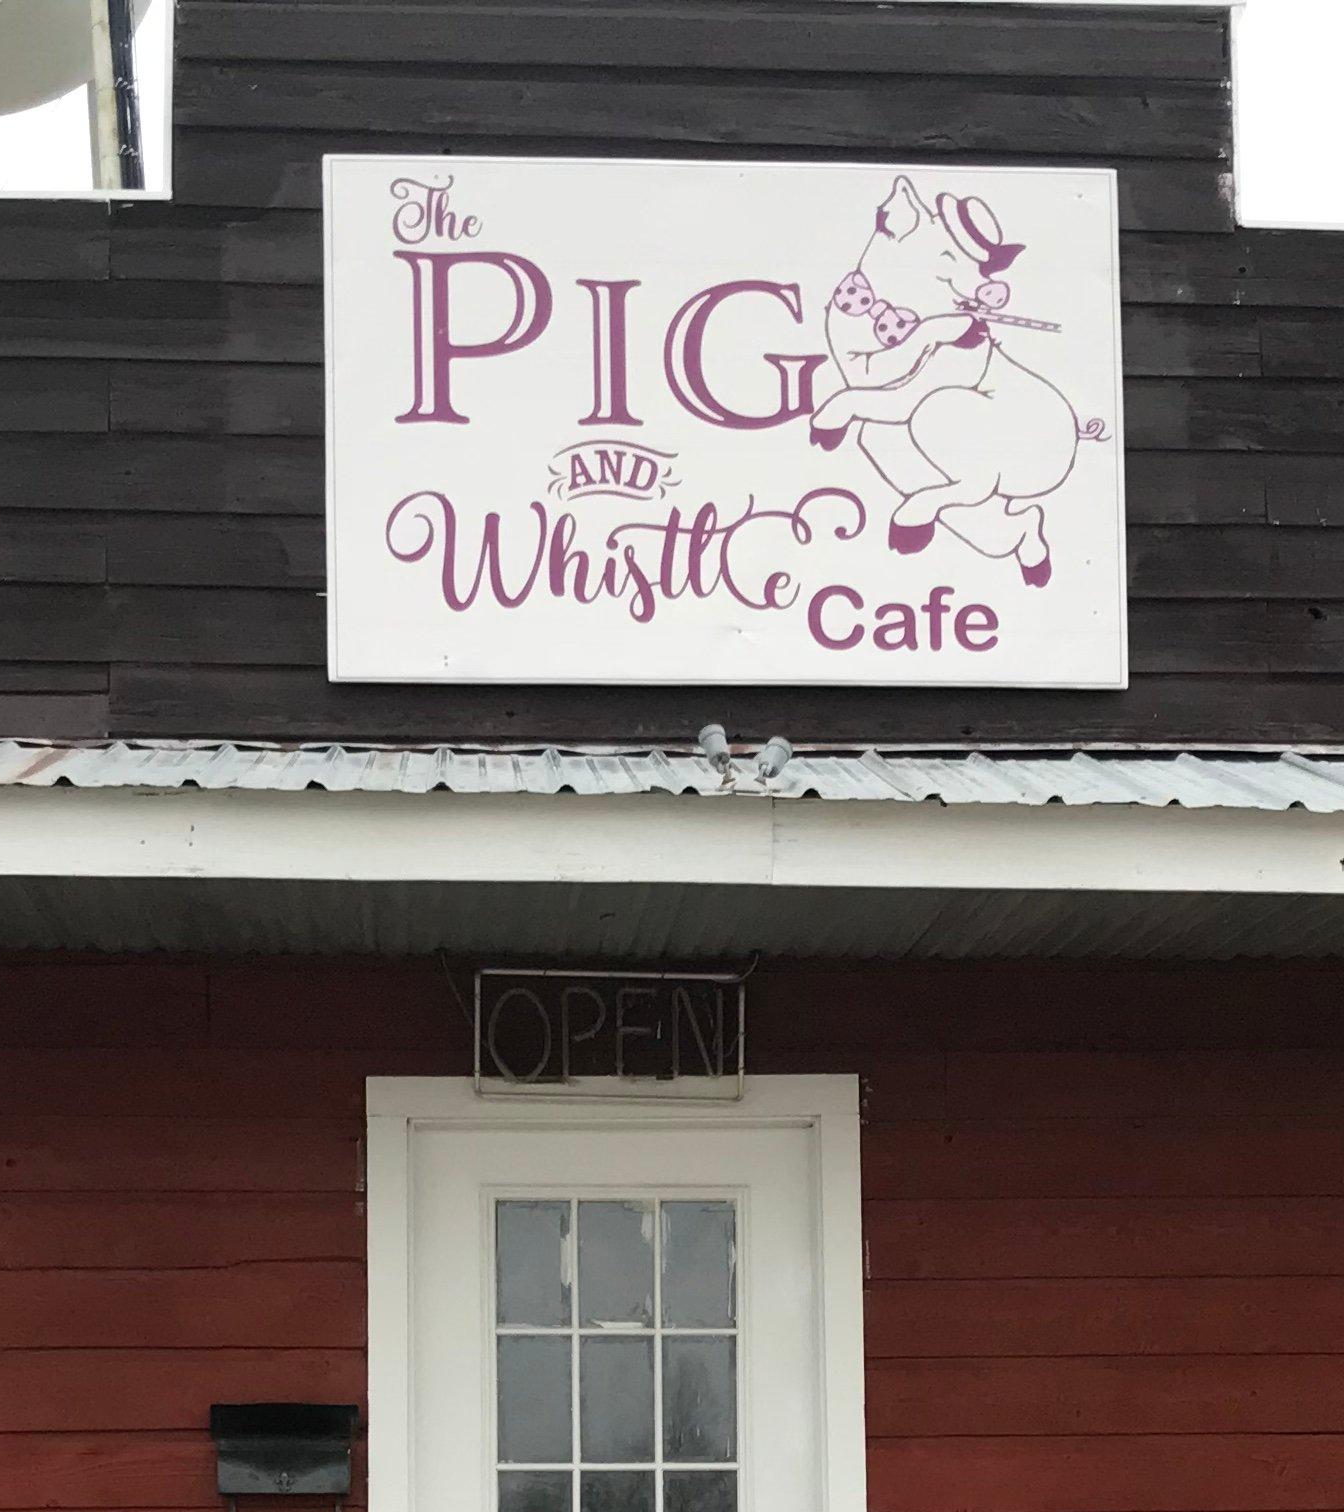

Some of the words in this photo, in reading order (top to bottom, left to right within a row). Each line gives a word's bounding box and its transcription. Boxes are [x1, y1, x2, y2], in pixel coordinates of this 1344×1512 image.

[390, 174, 482, 244] The
[393, 250, 828, 430] PIG
[567, 449, 662, 493] AND
[386, 487, 867, 624] Whistle
[807, 585, 1000, 653] Cafe
[488, 985, 724, 1083] OPEN
